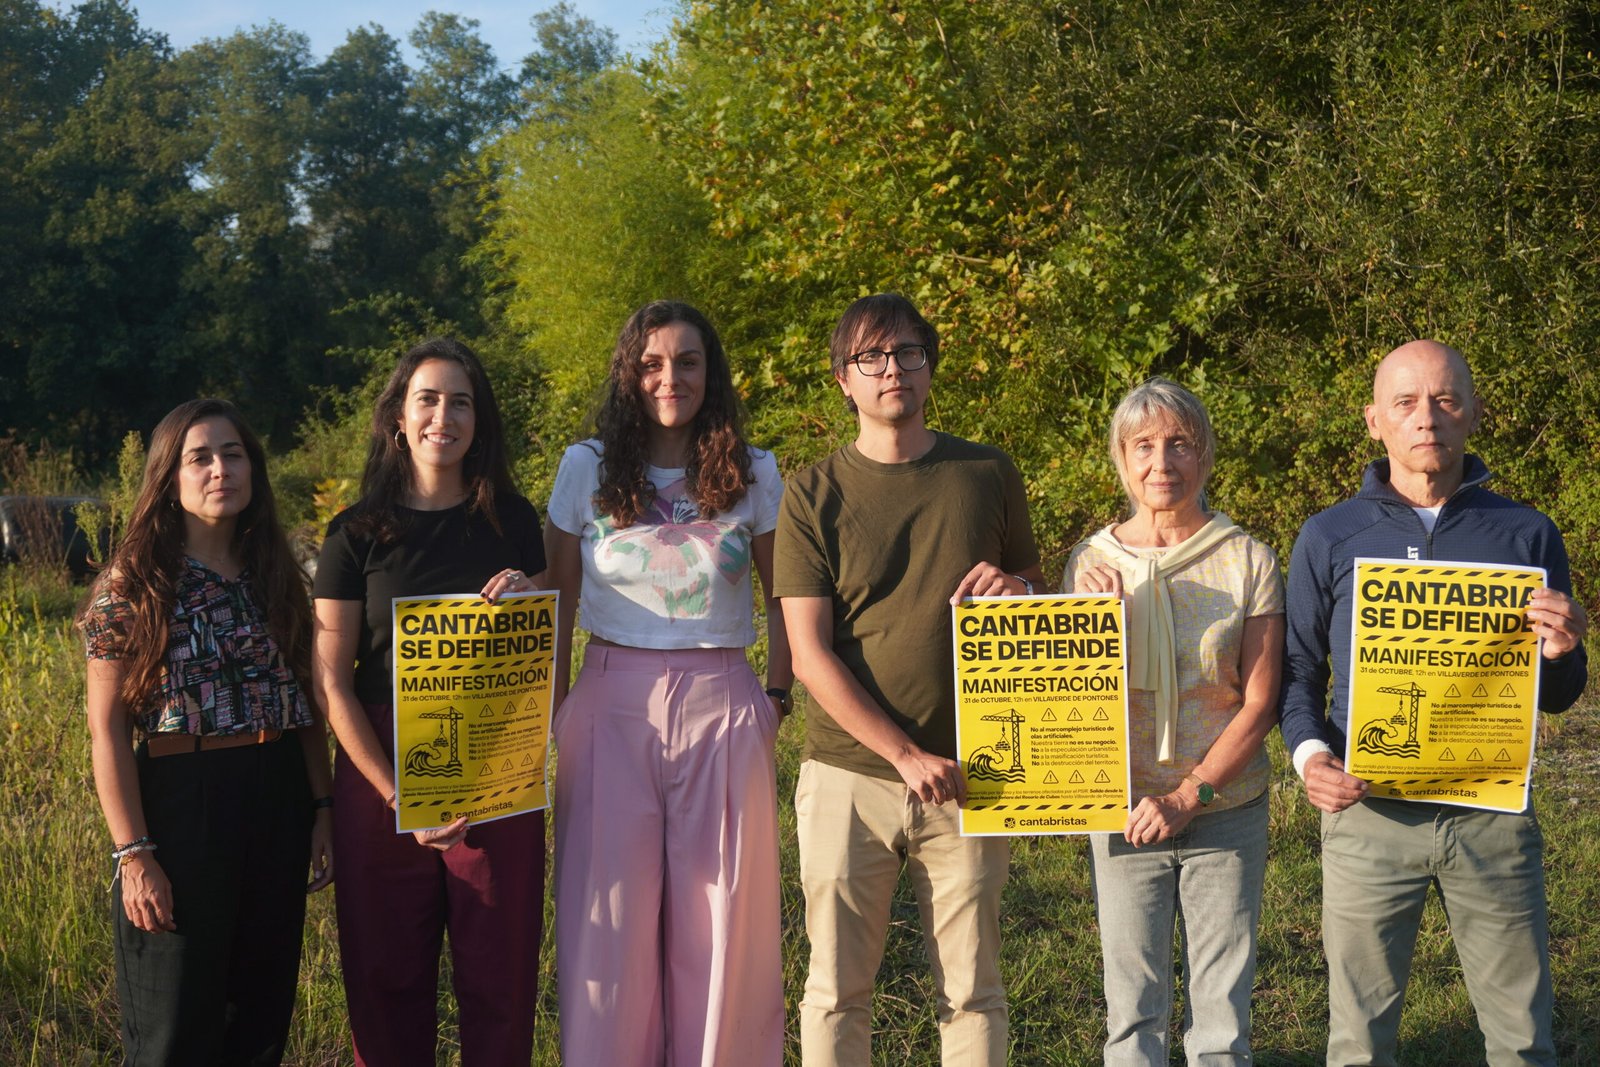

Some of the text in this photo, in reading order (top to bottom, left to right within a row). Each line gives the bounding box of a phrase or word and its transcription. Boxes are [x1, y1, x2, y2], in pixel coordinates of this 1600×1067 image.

[400, 608, 553, 636] CANTABRIA
[960, 612, 1120, 637] CANTABRIA
[1360, 607, 1396, 629] SE
[400, 632, 552, 660] SE DEFIENDE
[961, 638, 1120, 661] SE DEFIENDE
[1359, 646, 1531, 668] MANIFESTACIÓN
[402, 666, 548, 692] MANIFESTACIÓN
[962, 673, 1118, 694] MANIFESTACIÓN
[472, 691, 508, 700] VILLAVERDE
[516, 685, 547, 694] PONTONES
[1405, 787, 1478, 798] cantabristas
[456, 800, 513, 820] cantabristas
[1019, 817, 1087, 826] cantabristas
